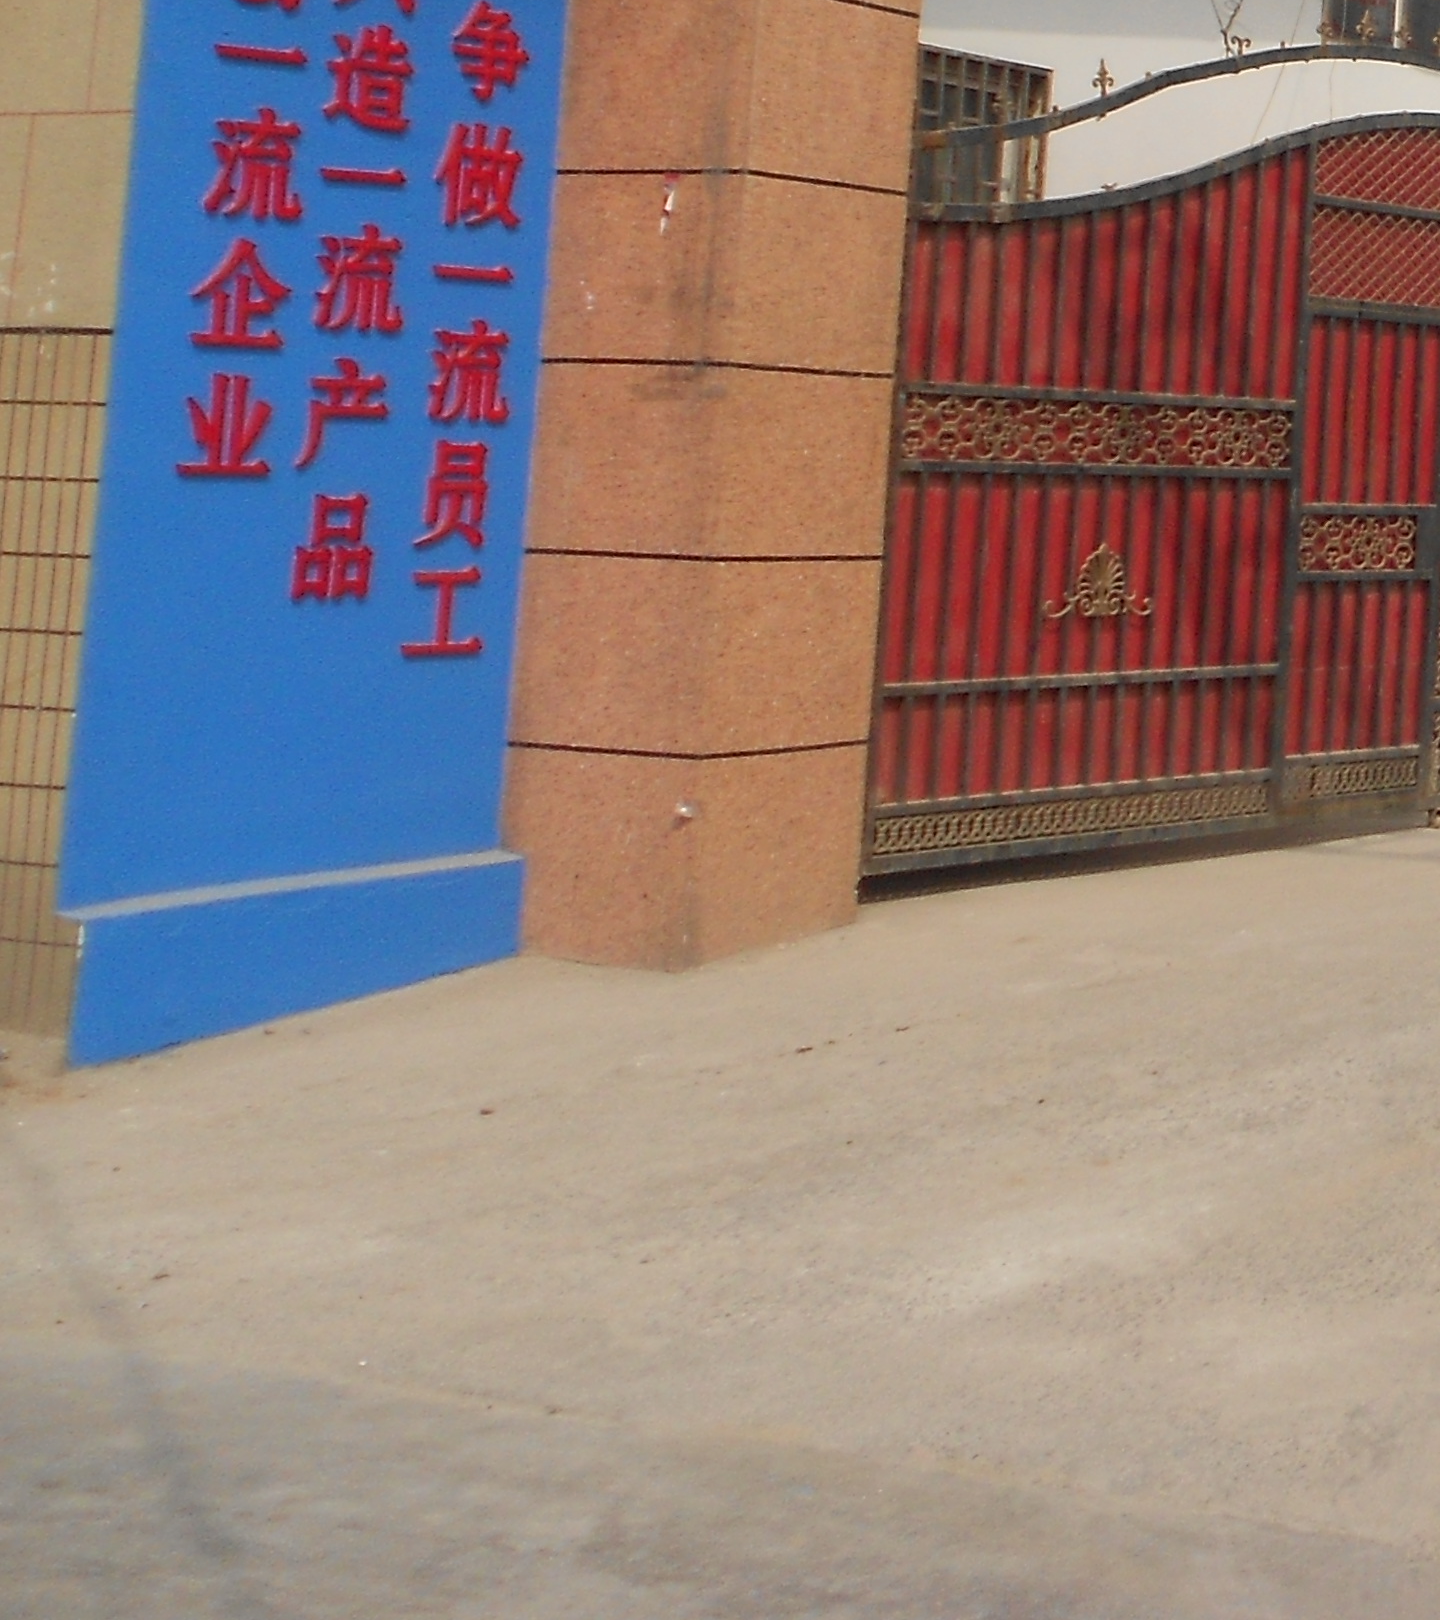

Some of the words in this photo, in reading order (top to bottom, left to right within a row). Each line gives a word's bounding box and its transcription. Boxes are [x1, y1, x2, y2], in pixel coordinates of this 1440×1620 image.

[400, 0, 531, 659] 争做一流员工
